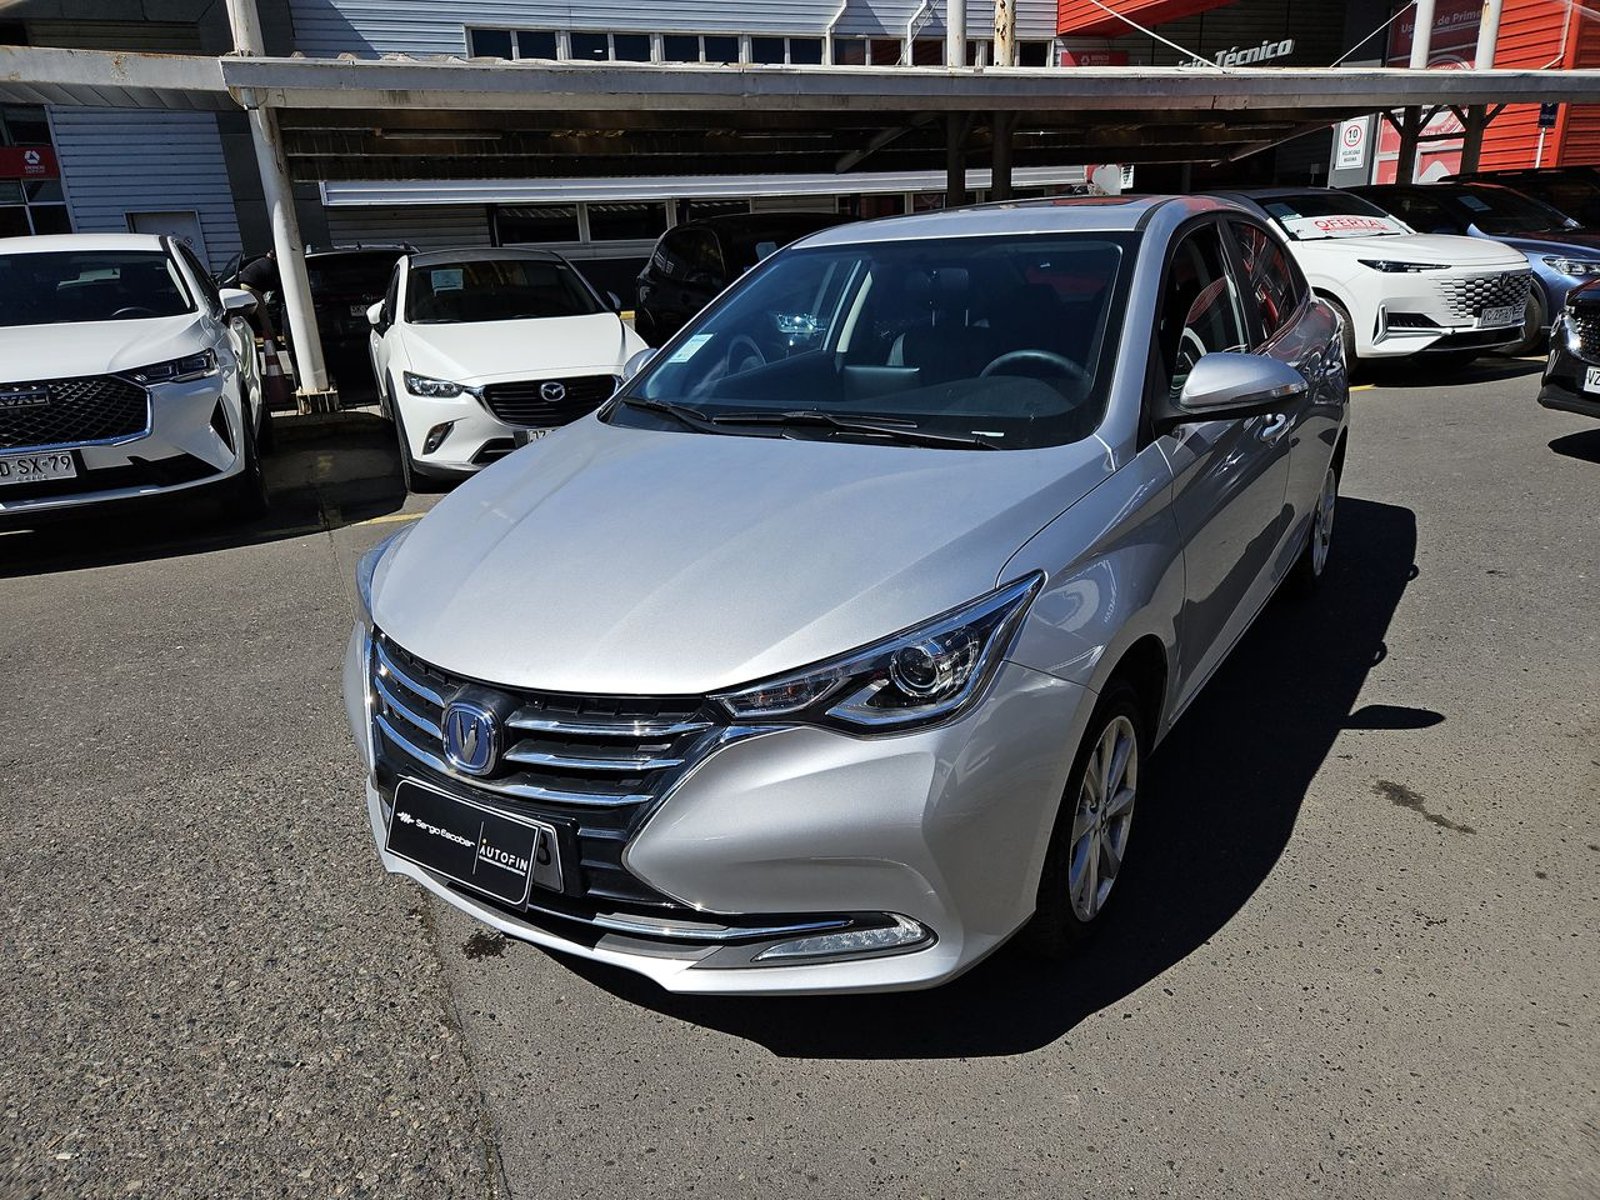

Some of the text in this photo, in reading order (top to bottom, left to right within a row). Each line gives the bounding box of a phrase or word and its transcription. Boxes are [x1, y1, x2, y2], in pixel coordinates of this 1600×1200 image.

[1214, 39, 1294, 67] Técnico
[1348, 129, 1359, 139] 10
[479, 844, 528, 872] AUTOFIN
